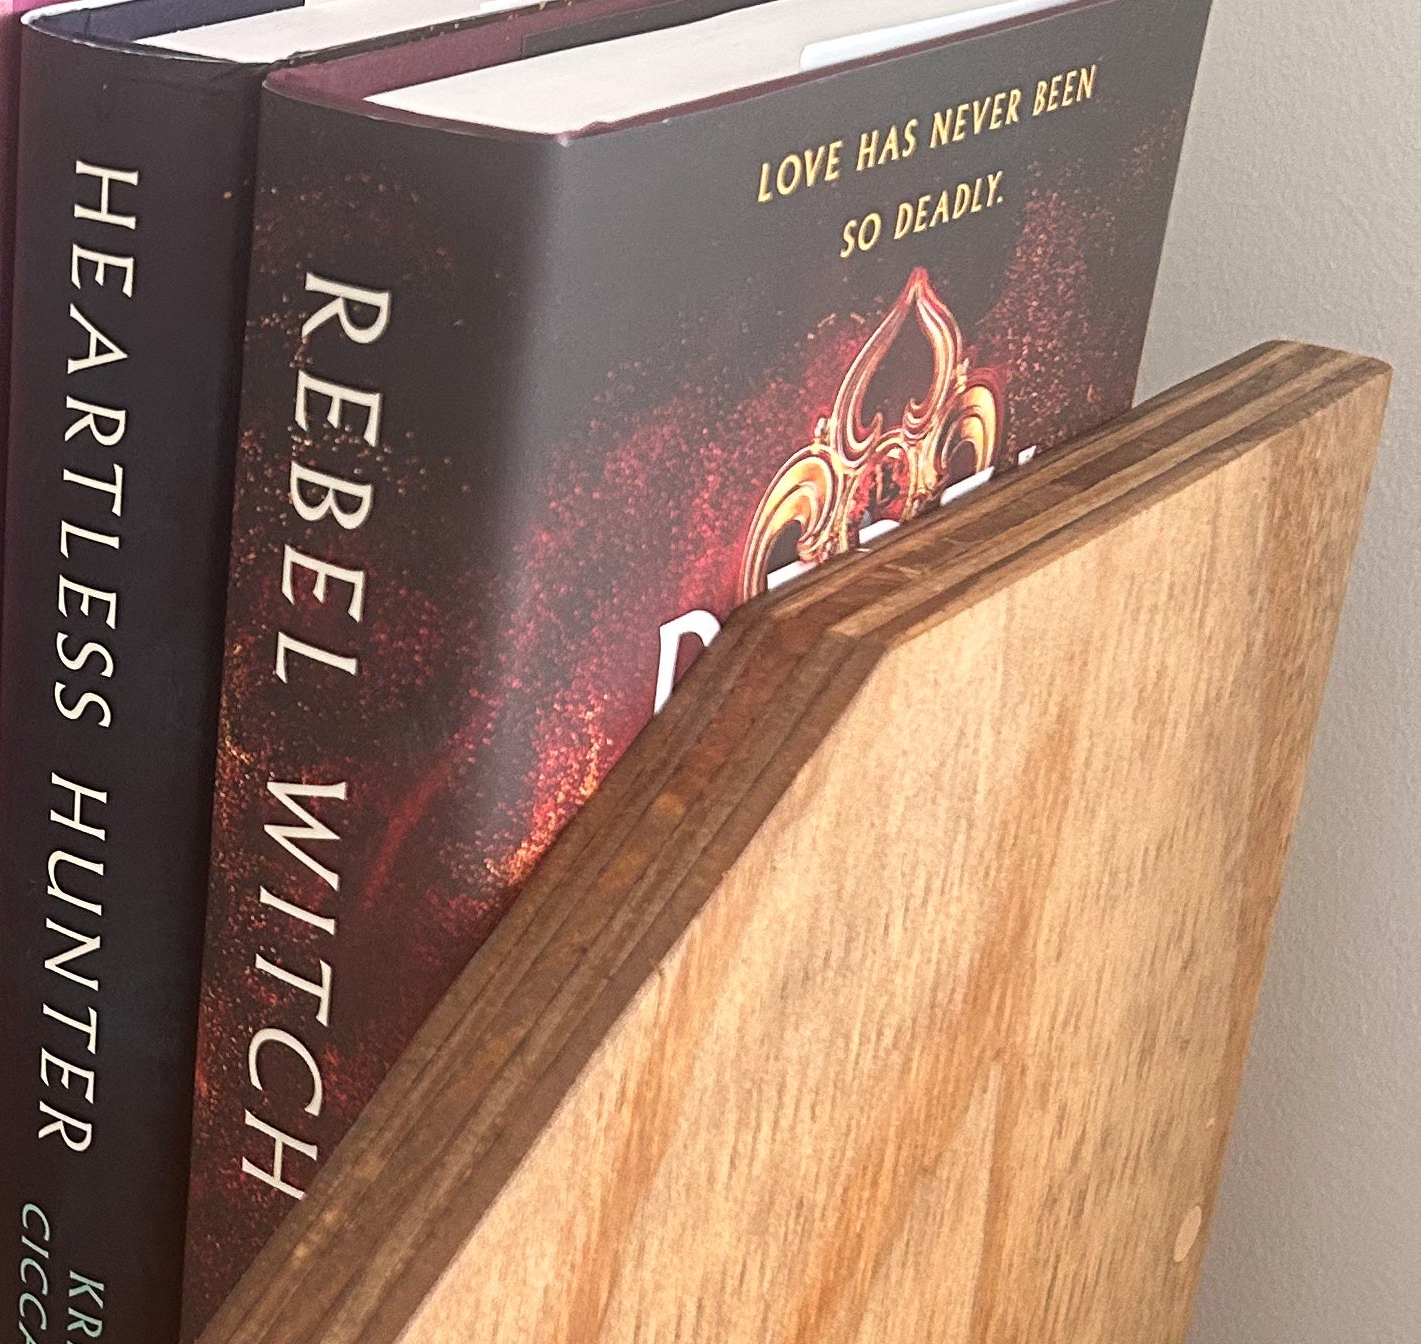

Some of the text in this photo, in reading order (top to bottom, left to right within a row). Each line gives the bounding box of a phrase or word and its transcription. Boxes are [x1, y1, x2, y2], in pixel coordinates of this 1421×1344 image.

[756, 64, 1098, 203] LOVE HAS NEVER BEEN
[840, 169, 1005, 259] SO DEADLY.
[35, 159, 140, 1154] HEARTLESS HUNTER
[239, 271, 393, 1201] REBEL WITCH
